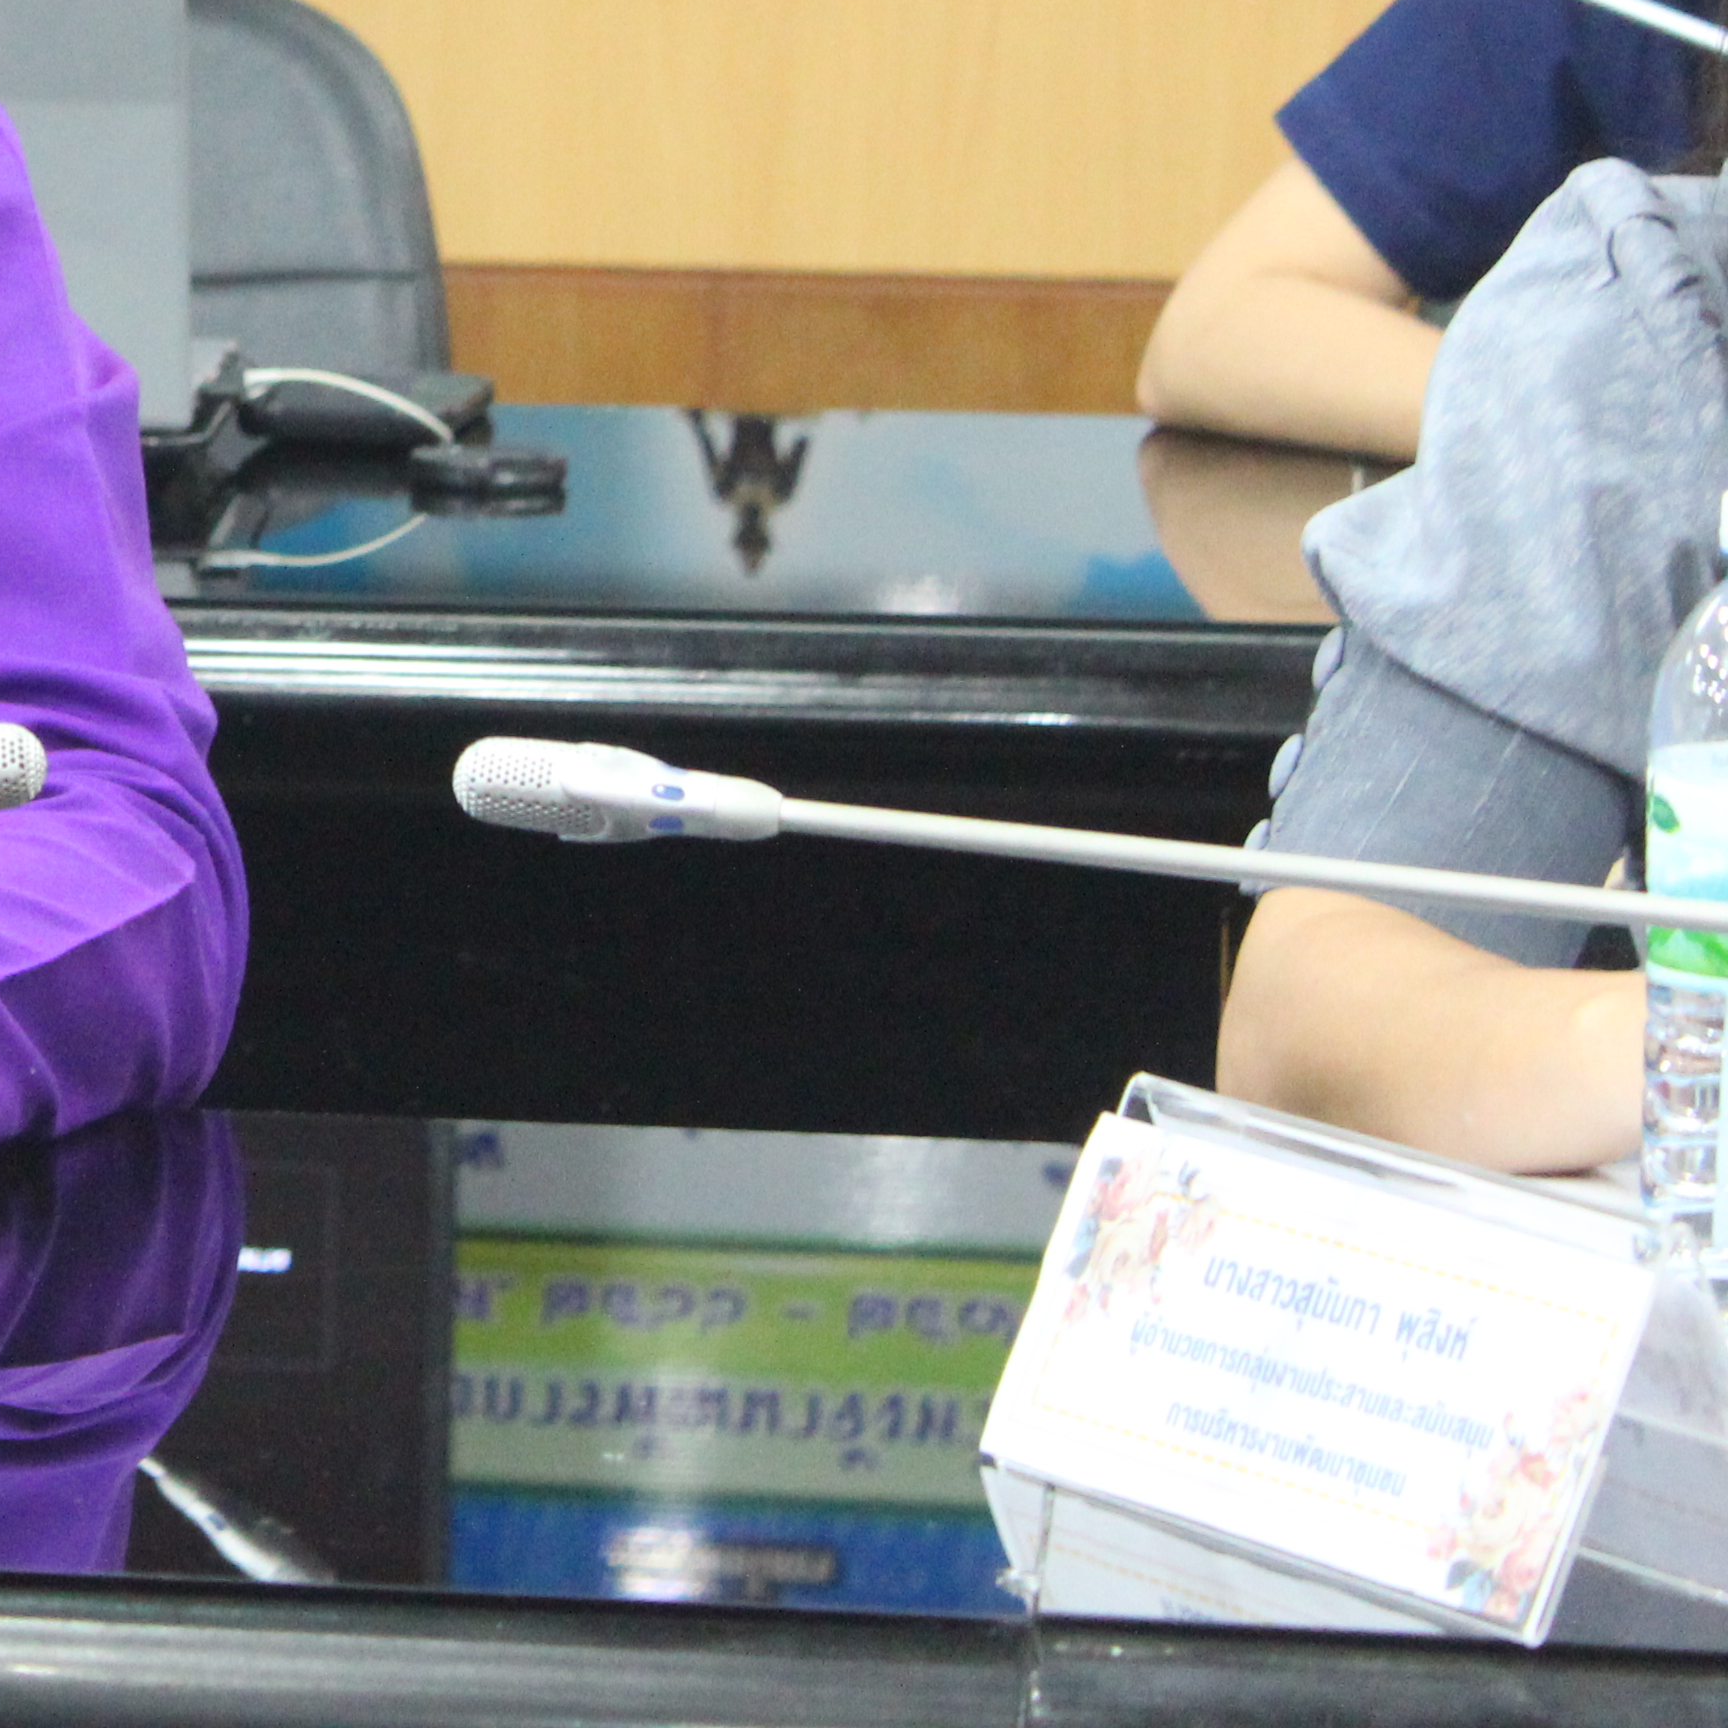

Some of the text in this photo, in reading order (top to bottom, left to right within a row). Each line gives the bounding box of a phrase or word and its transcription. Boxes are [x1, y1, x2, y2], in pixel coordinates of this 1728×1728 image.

[1164, 1399, 1408, 1498] การบริหารงานพัฒนาชุมชน
